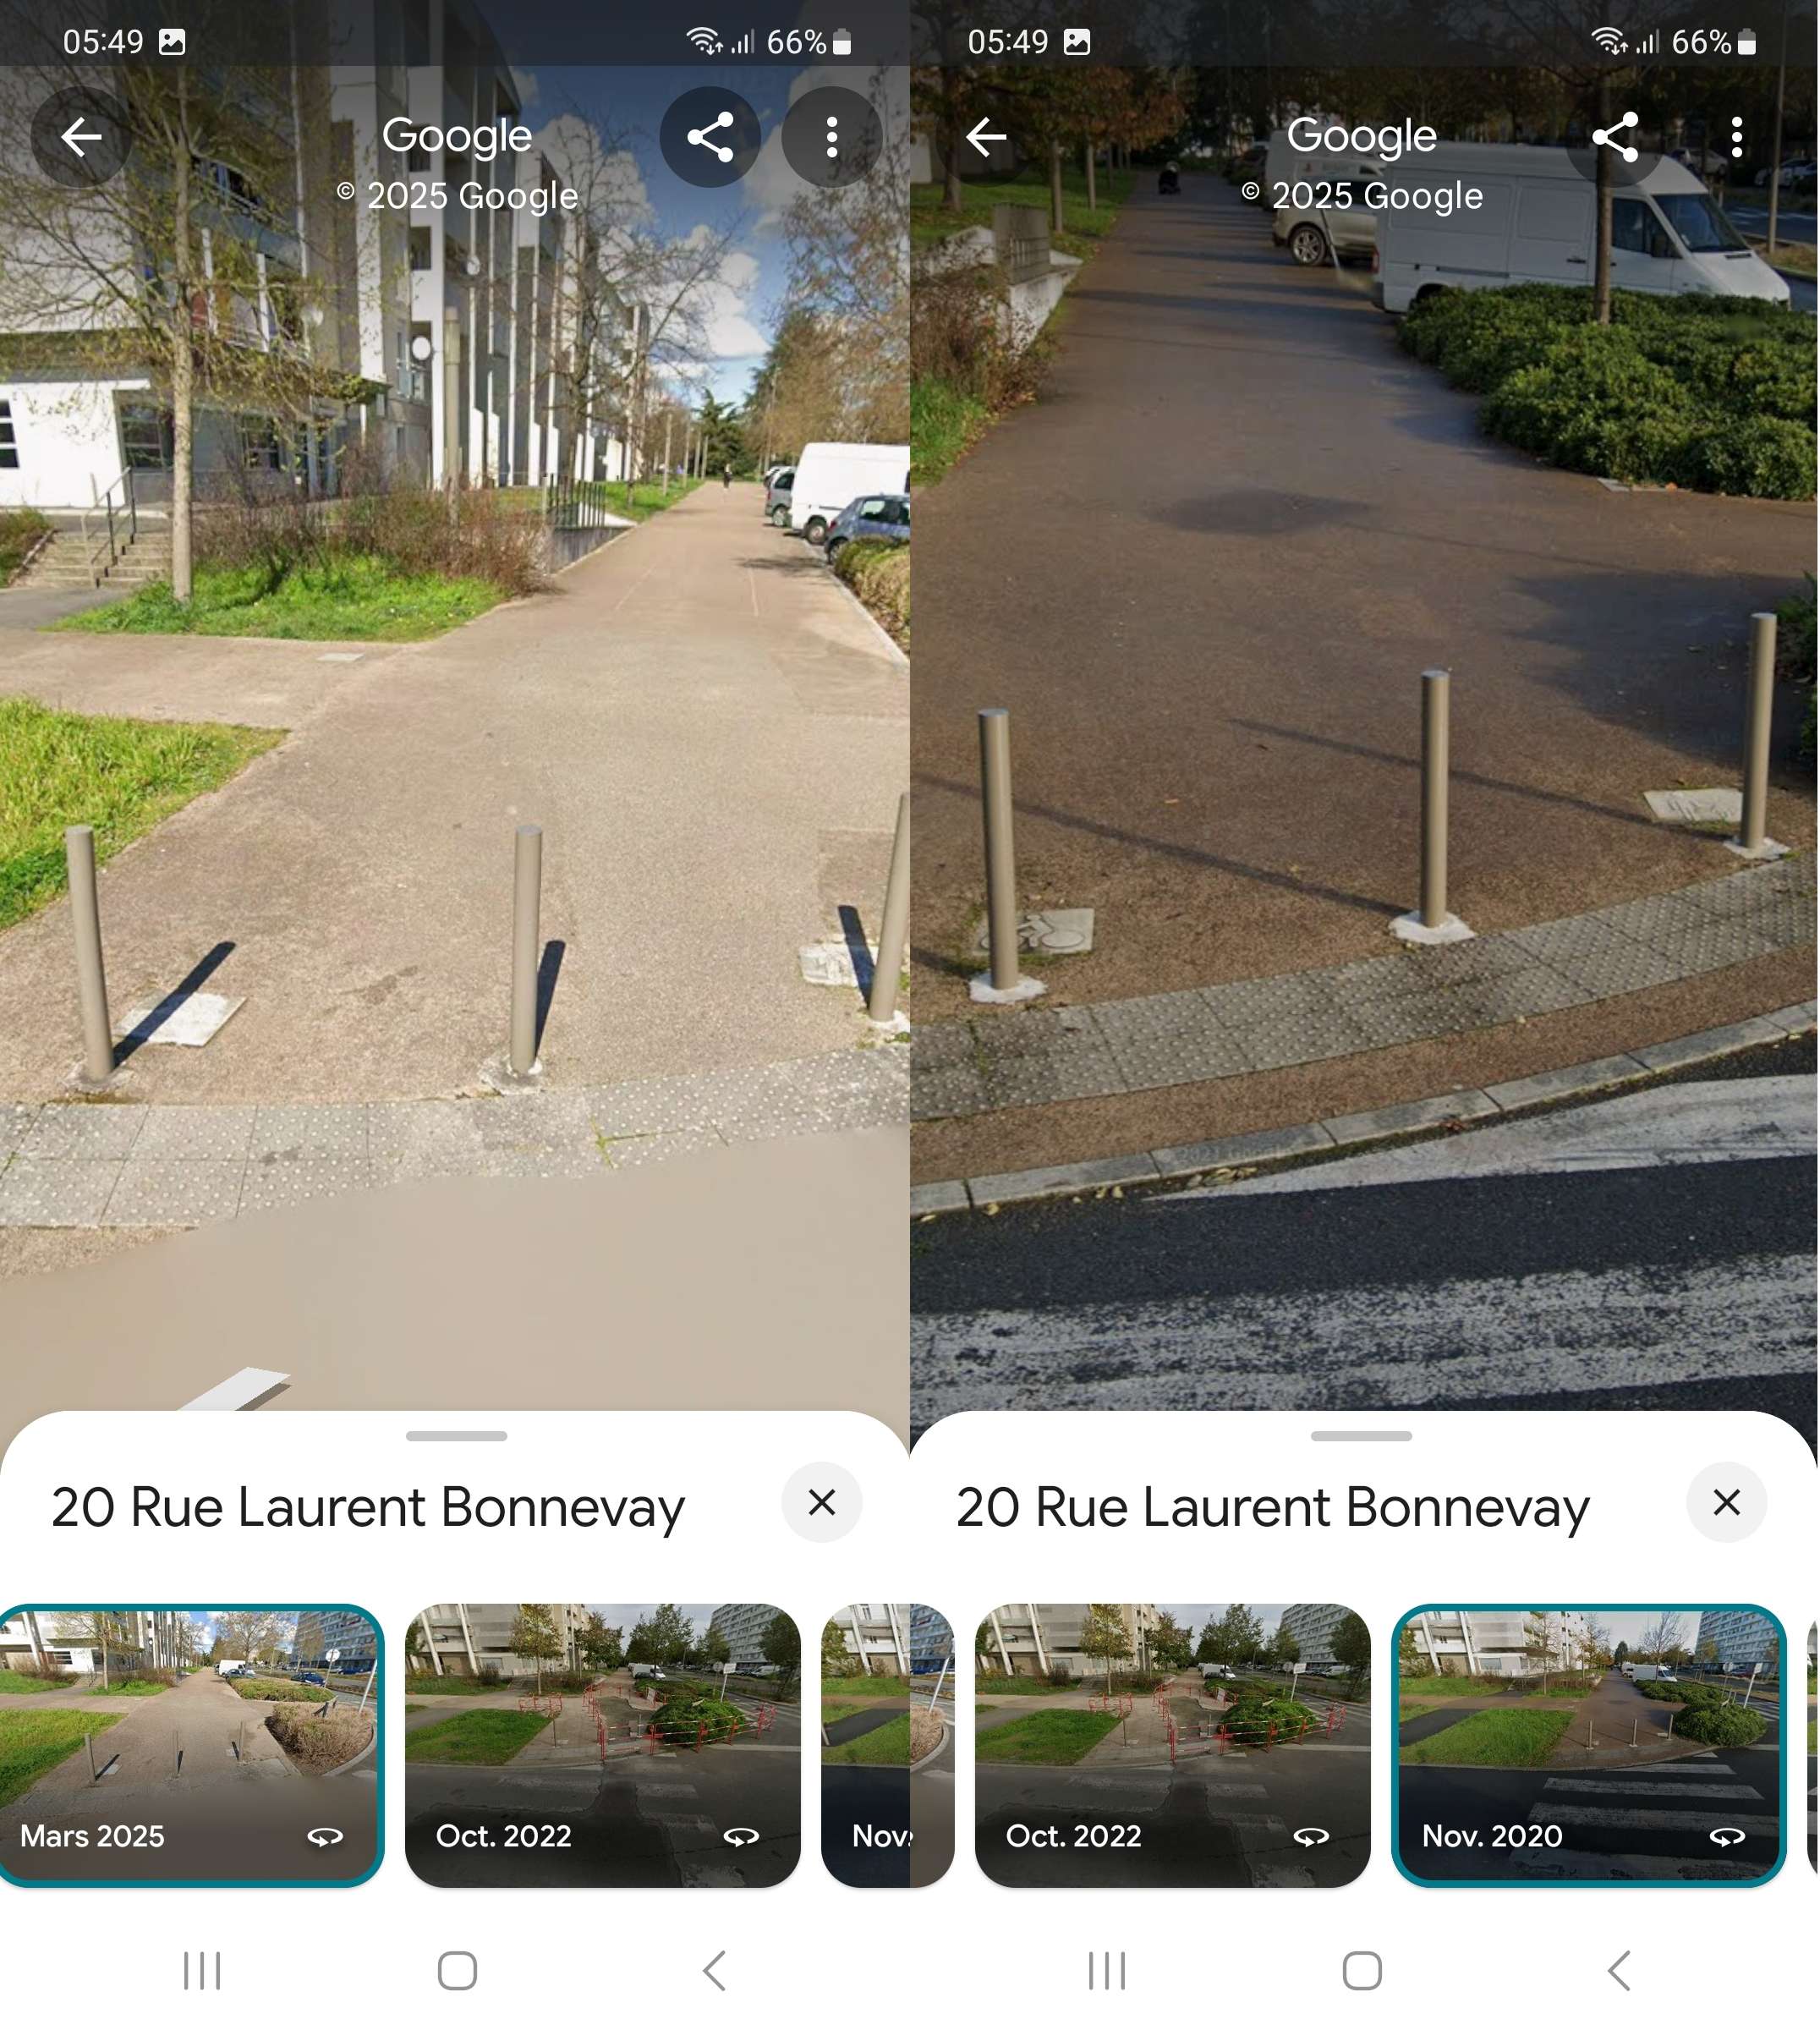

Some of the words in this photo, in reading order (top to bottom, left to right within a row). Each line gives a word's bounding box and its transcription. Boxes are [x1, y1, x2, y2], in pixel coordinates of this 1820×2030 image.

[64, 30, 144, 55] 05:49
[769, 30, 828, 55] 66%
[969, 30, 1049, 55] 05:49
[1674, 30, 1733, 55] 66%
[53, 1486, 115, 1528] 20
[134, 1486, 223, 1528] Rue
[242, 1486, 426, 1528] Laurent
[445, 1486, 687, 1539] Bonnevay
[958, 1486, 1020, 1528] 20
[1039, 1486, 1128, 1528] Rue
[1147, 1486, 1331, 1528] Laurent
[1350, 1486, 1592, 1539] Bonnevay
[22, 1824, 90, 1848] Mars
[98, 1825, 165, 1848] 2025
[437, 1824, 496, 1848] Oct.
[505, 1825, 572, 1848] 2022
[1007, 1824, 1066, 1848] Oct.
[1075, 1825, 1142, 1848] 2022
[1424, 1824, 1484, 1848] Nov.
[1493, 1825, 1564, 1848] 2020
